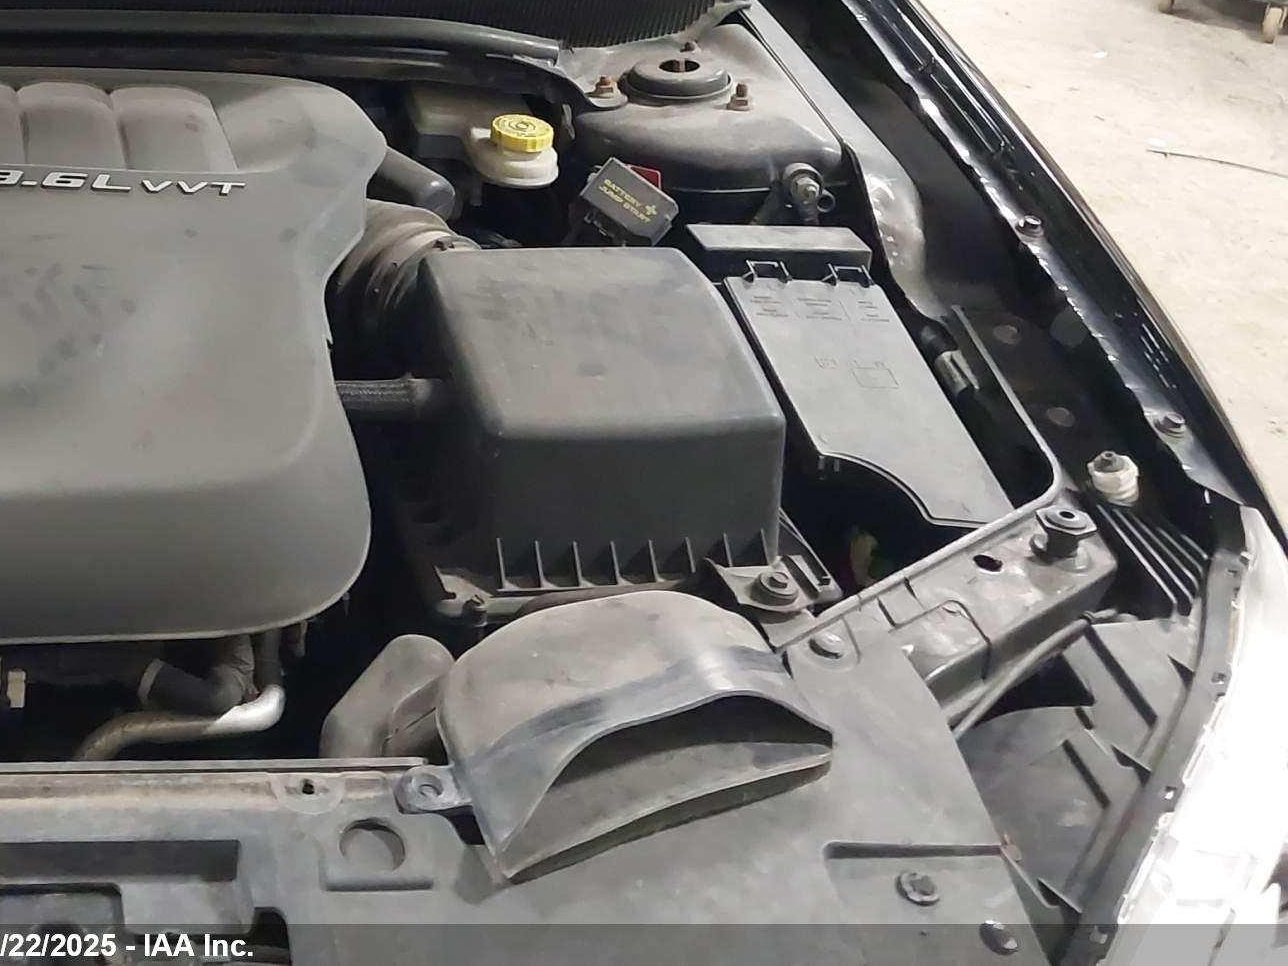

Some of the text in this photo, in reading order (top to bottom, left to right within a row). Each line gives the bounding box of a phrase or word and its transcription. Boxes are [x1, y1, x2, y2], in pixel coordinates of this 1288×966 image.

[141, 179, 246, 196] VVT
[603, 178, 642, 207] BATTERY
[598, 185, 651, 222] JUMP START
